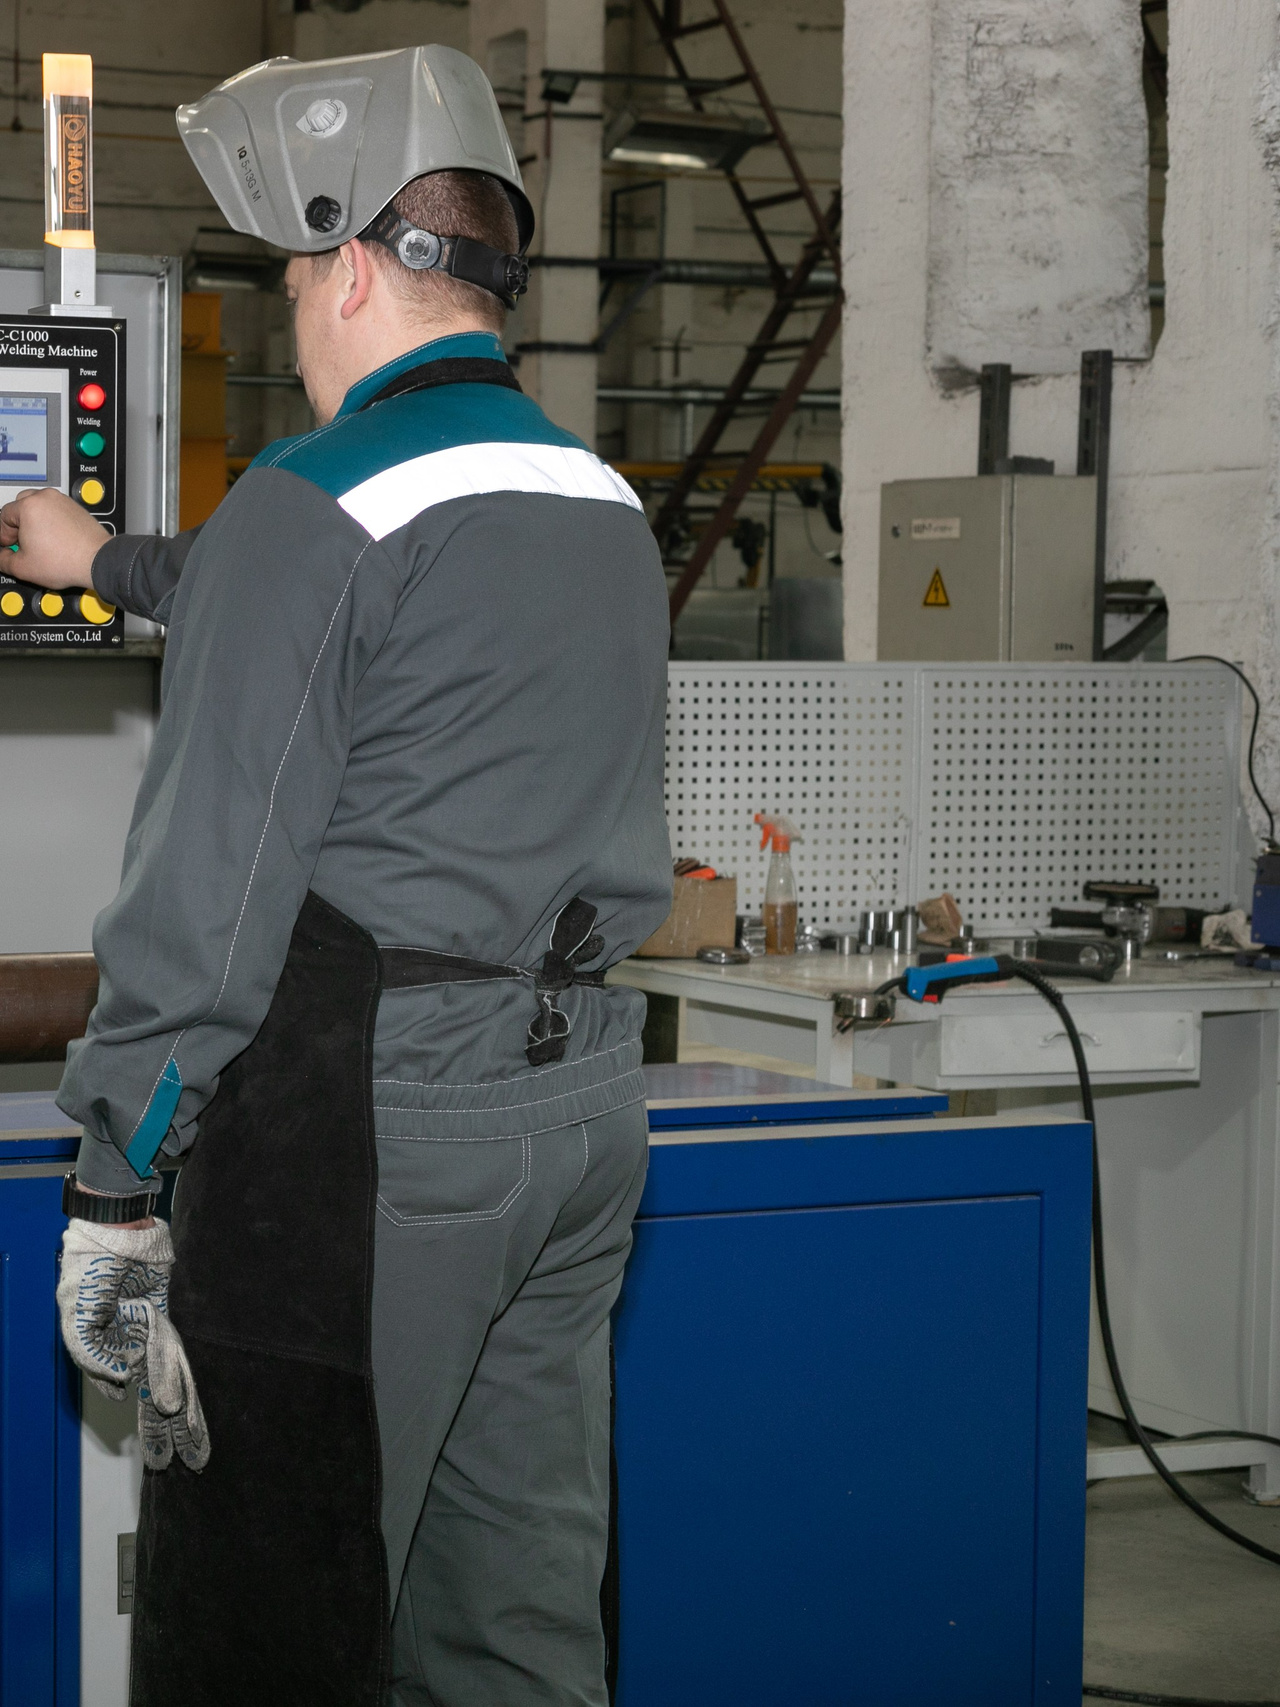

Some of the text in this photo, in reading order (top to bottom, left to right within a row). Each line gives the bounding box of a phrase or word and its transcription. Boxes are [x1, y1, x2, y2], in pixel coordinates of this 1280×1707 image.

[67, 143, 84, 210] HAOYU
[237, 145, 248, 160] IQ
[251, 190, 262, 203] M
[48, 345, 98, 358] Machine
[80, 368, 98, 376] Power
[76, 417, 101, 427] Welding
[80, 464, 98, 472] Reset
[30, 630, 64, 644] System
[66, 630, 102, 643] Co.,Ltd
